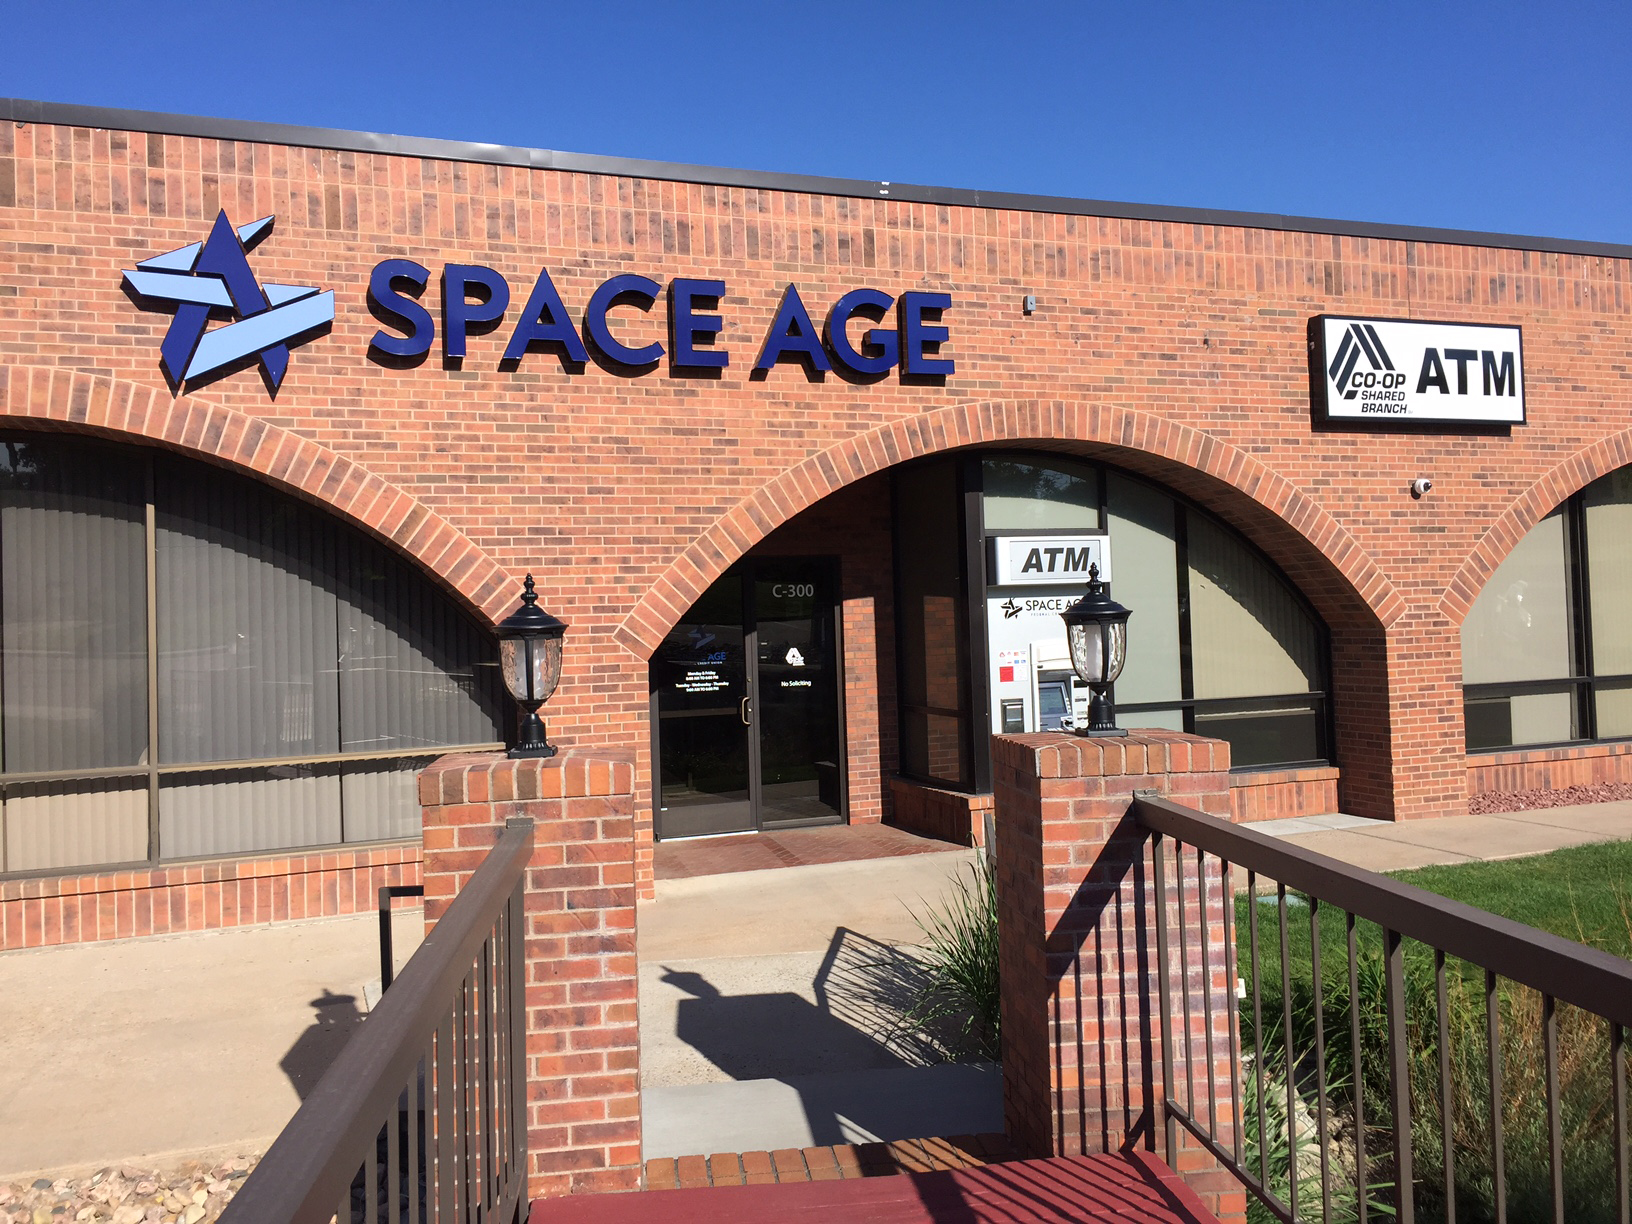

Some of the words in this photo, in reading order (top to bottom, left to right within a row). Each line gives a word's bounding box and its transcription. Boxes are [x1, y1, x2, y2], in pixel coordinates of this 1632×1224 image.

[367, 257, 730, 369] SPACE
[750, 281, 955, 377] AGE
[1415, 347, 1516, 397] ATM
[1351, 371, 1407, 390] CO-OP
[1361, 390, 1406, 402] SHARED
[1361, 402, 1408, 414] BRANCH
[1021, 547, 1090, 573] ATM
[772, 584, 814, 598] C-300
[1025, 599, 1062, 612] SPACE
[707, 651, 727, 660] AGE
